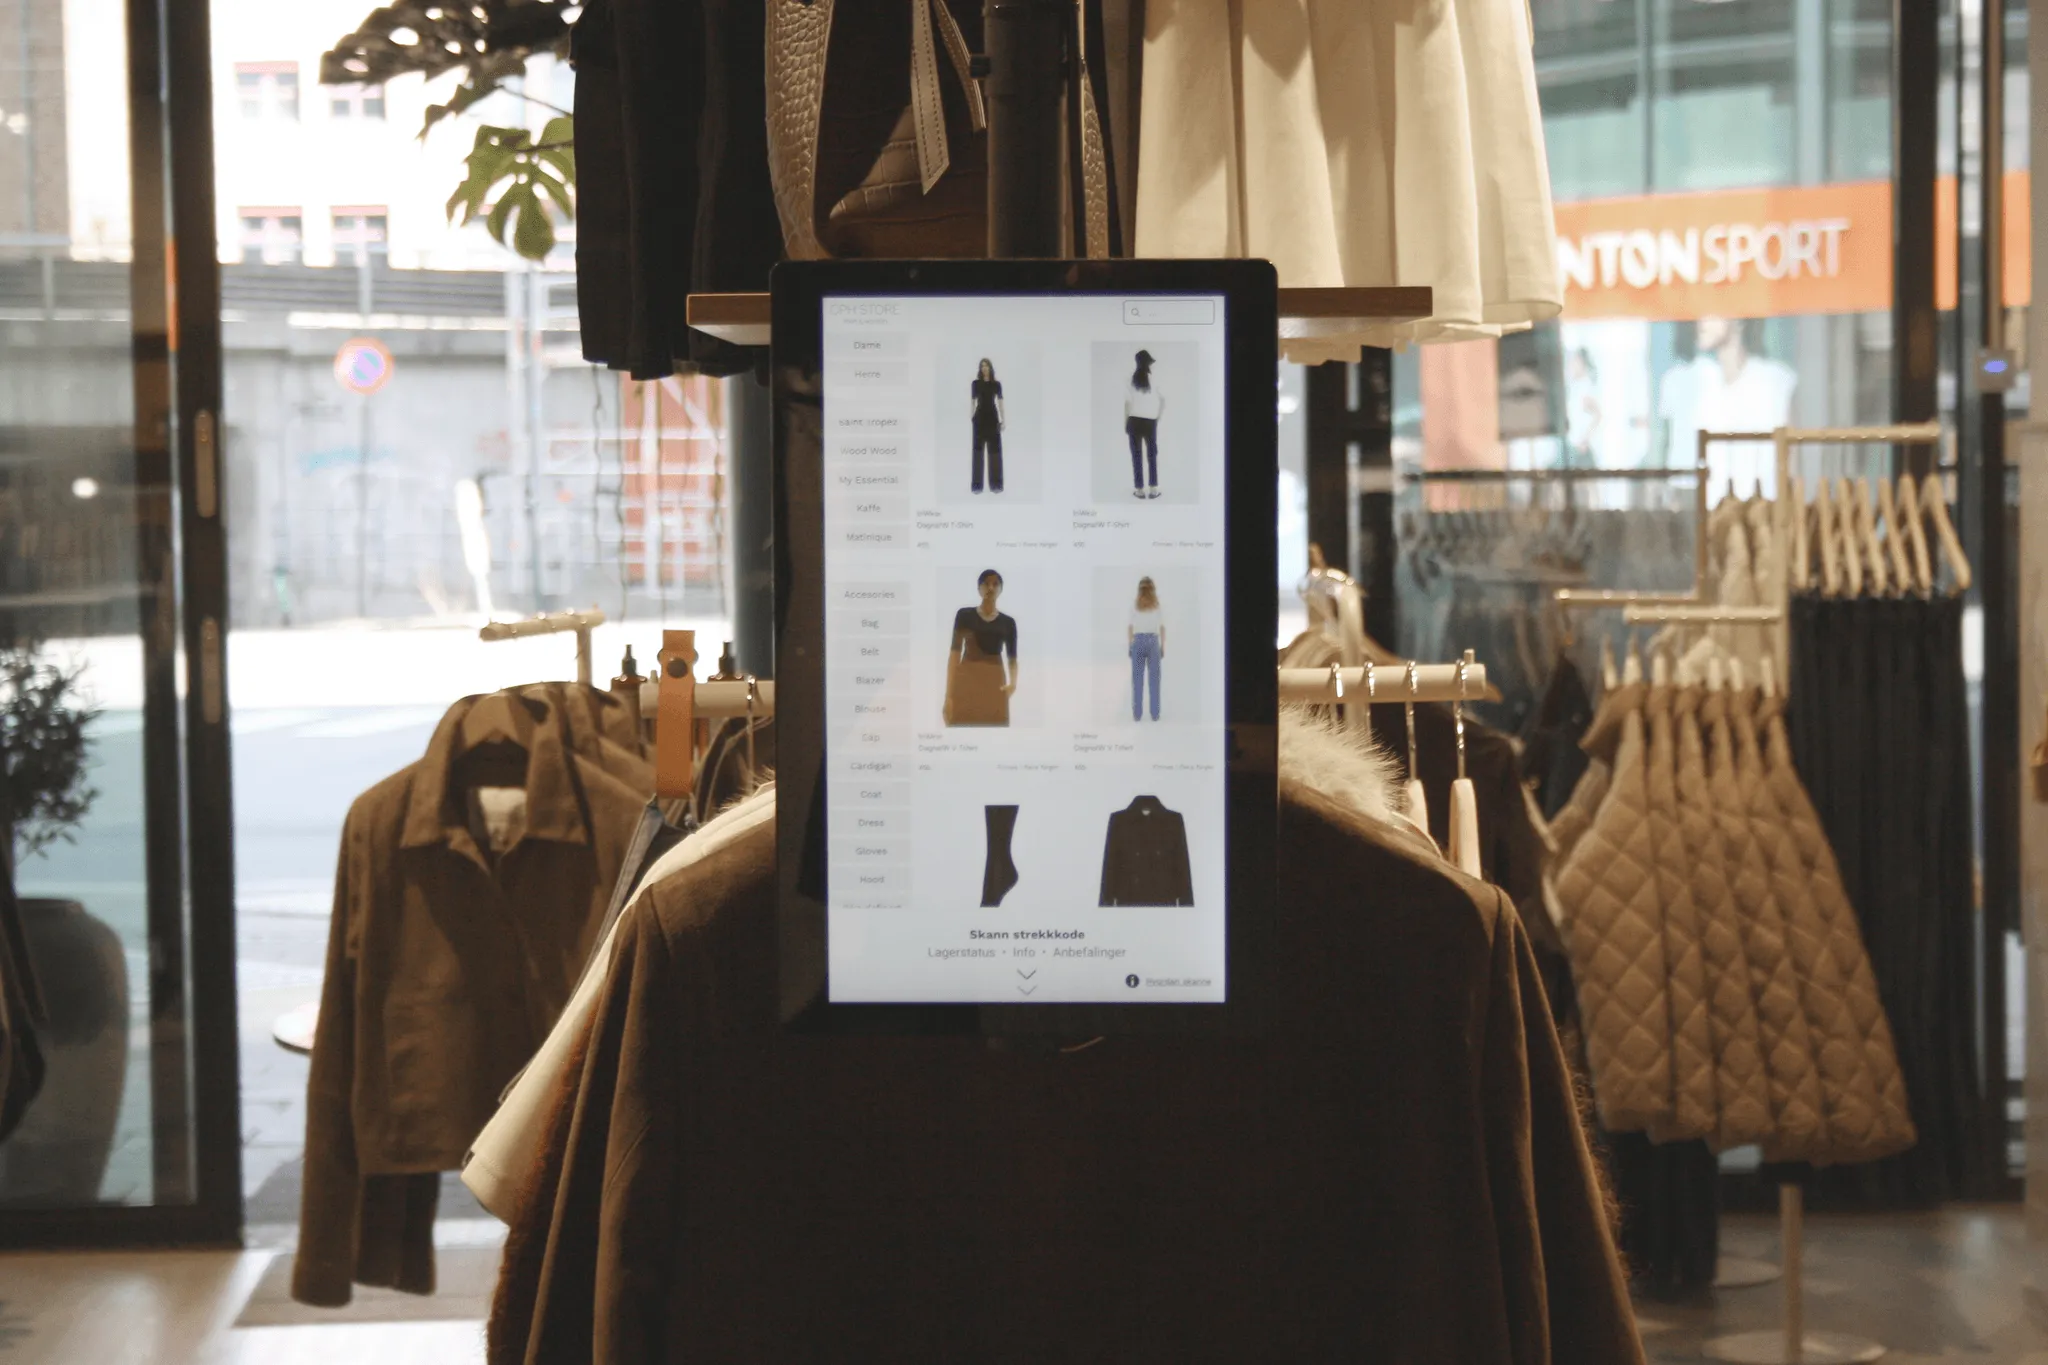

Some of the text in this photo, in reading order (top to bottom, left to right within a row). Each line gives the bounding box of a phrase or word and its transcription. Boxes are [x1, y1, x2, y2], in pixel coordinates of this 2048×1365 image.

[860, 302, 900, 315] STORE
[853, 340, 881, 350] Dame
[854, 369, 881, 379] Herre
[840, 445, 897, 455] Wood Wood
[839, 475, 898, 486] My Essential
[856, 503, 881, 513] Kaffe
[846, 532, 893, 543] Matinique
[861, 618, 879, 629] Bag
[861, 647, 880, 656] Belt
[856, 675, 885, 685] Blazer
[854, 704, 887, 714] Blouse
[862, 733, 880, 743] Cap
[850, 761, 892, 772] Cardigan
[860, 790, 882, 799] Coat
[858, 818, 885, 828] Dress
[855, 847, 888, 856] Gloves
[860, 875, 885, 884] Hood
[969, 929, 1085, 940] Skann strekkkode
[927, 946, 1127, 958] Lagerstatus Info Anbefalinger
